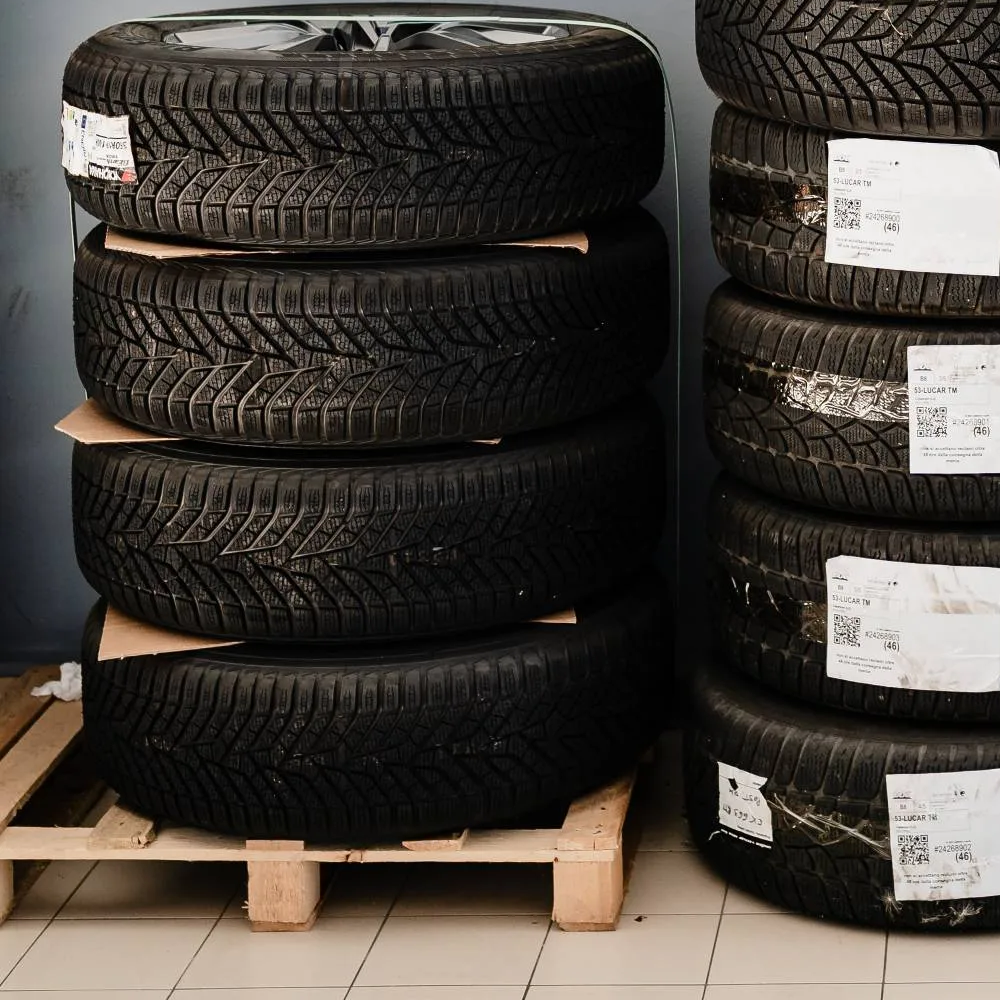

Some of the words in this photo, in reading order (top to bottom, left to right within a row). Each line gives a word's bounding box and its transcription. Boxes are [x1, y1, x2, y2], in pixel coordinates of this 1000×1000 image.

[883, 222, 900, 234] (46)
[948, 386, 958, 394] TM
[973, 426, 991, 438] (46)
[883, 641, 900, 653] (46)
[955, 852, 972, 863] (46)
